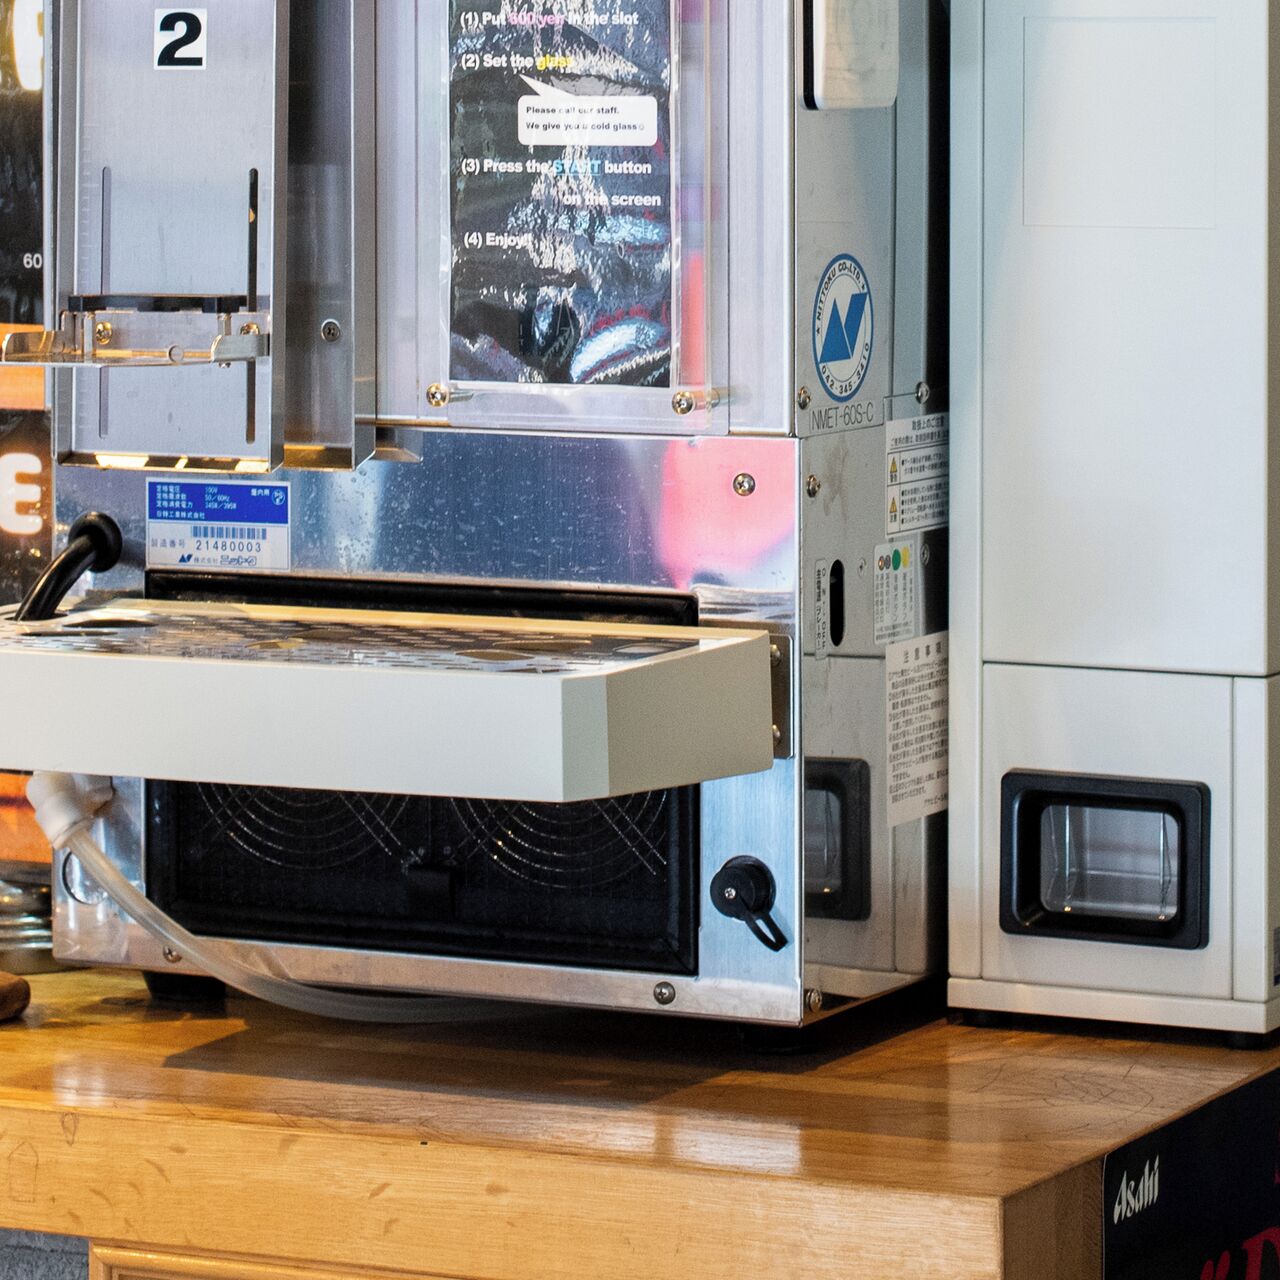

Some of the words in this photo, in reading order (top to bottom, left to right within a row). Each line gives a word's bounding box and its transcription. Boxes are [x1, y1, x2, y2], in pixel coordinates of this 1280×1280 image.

[460, 12, 479, 28] (1)
[482, 11, 506, 25] Put
[567, 11, 580, 25] in
[583, 11, 609, 25] the
[611, 11, 639, 25] slot
[156, 11, 204, 68] 2
[461, 53, 480, 70] (2)
[482, 54, 508, 68] Set
[510, 54, 534, 68] the
[525, 105, 557, 115] Please
[525, 122, 541, 131] We
[542, 122, 561, 132] give
[590, 122, 611, 131] cold
[461, 158, 480, 175] (3)
[483, 158, 523, 173] Press
[604, 159, 652, 174] button
[563, 195, 581, 206] on
[584, 193, 609, 206] the
[611, 195, 661, 206] screen
[464, 232, 483, 248] (4)
[817, 267, 837, 321] NITTOKU
[811, 401, 874, 431] NMET-60S-C
[195, 539, 262, 553] 21480003
[1112, 1154, 1161, 1226] Asahi
